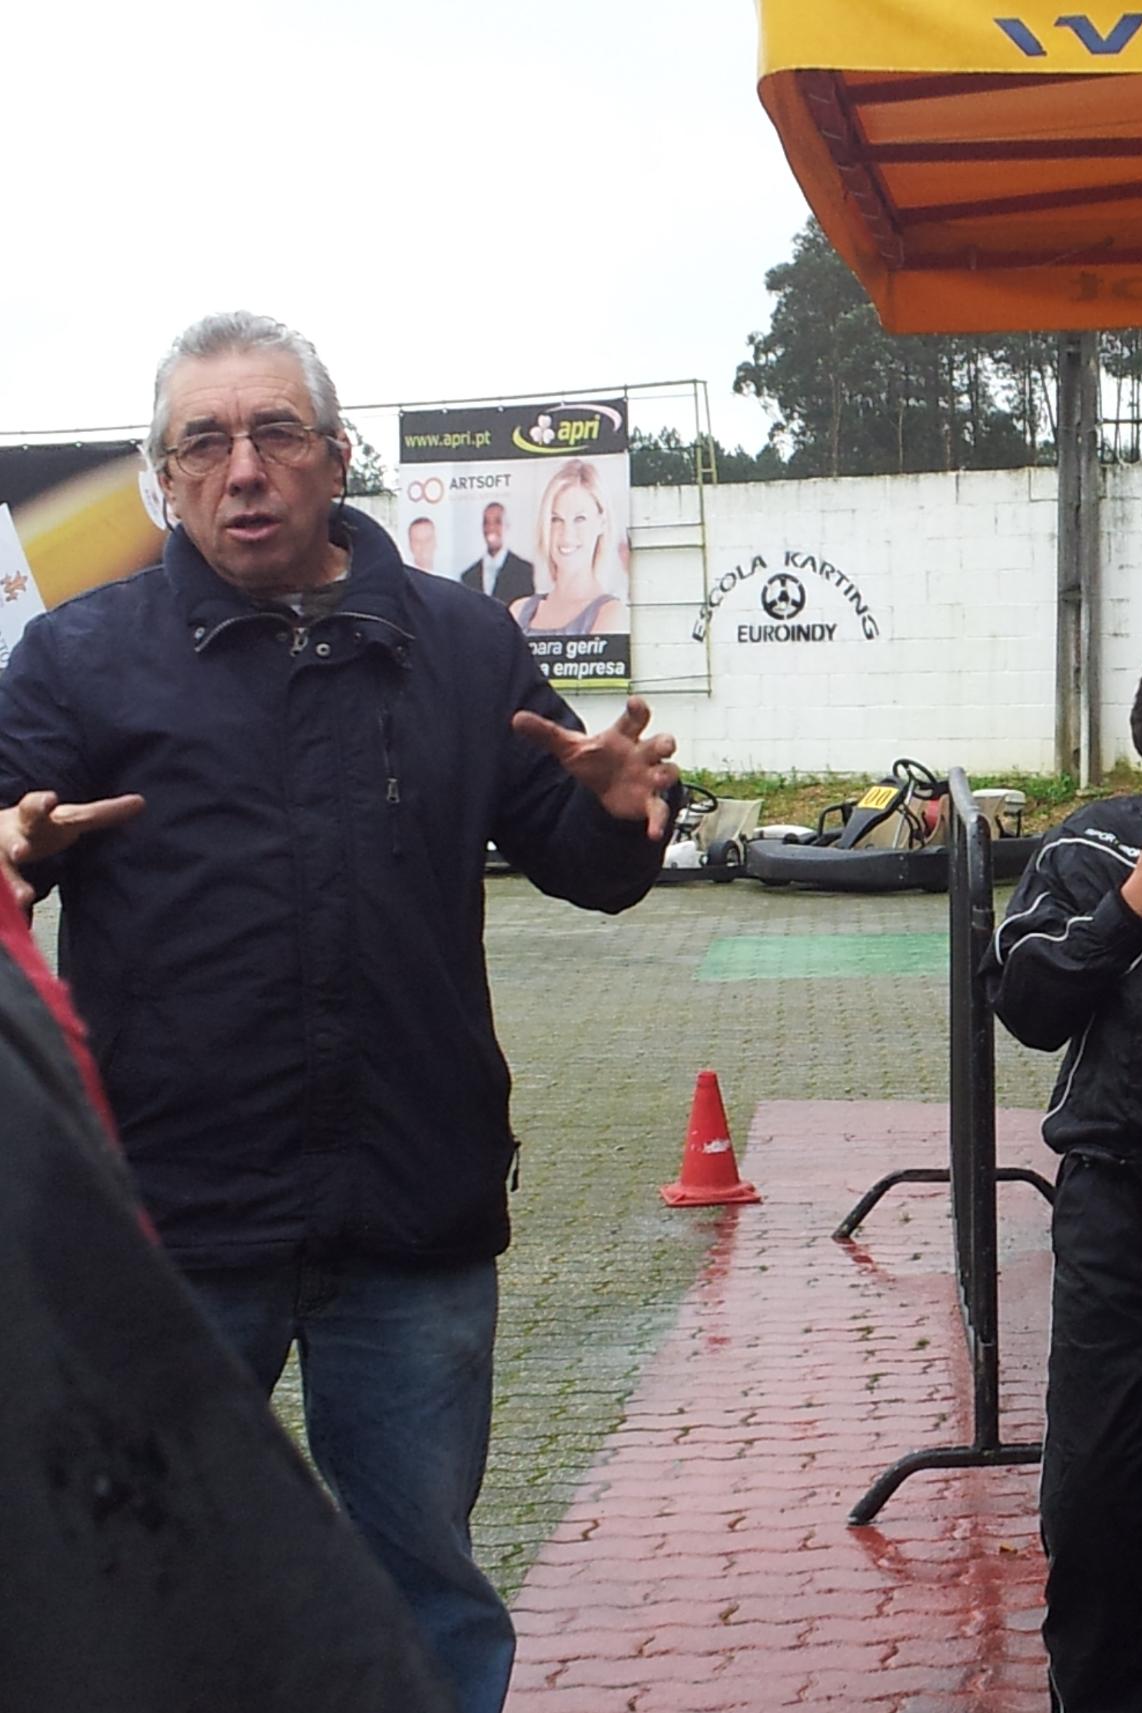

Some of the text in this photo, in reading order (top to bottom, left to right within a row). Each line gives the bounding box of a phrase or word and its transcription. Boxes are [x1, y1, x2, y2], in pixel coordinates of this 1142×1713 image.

[557, 409, 601, 445] apri
[404, 430, 492, 450] www.apri.pt
[449, 474, 511, 490] ARTSOFT
[692, 551, 880, 642] ESCOLA KARTING
[737, 622, 838, 643] EUROINDY
[566, 637, 607, 659] gerir
[553, 661, 625, 680] empresa
